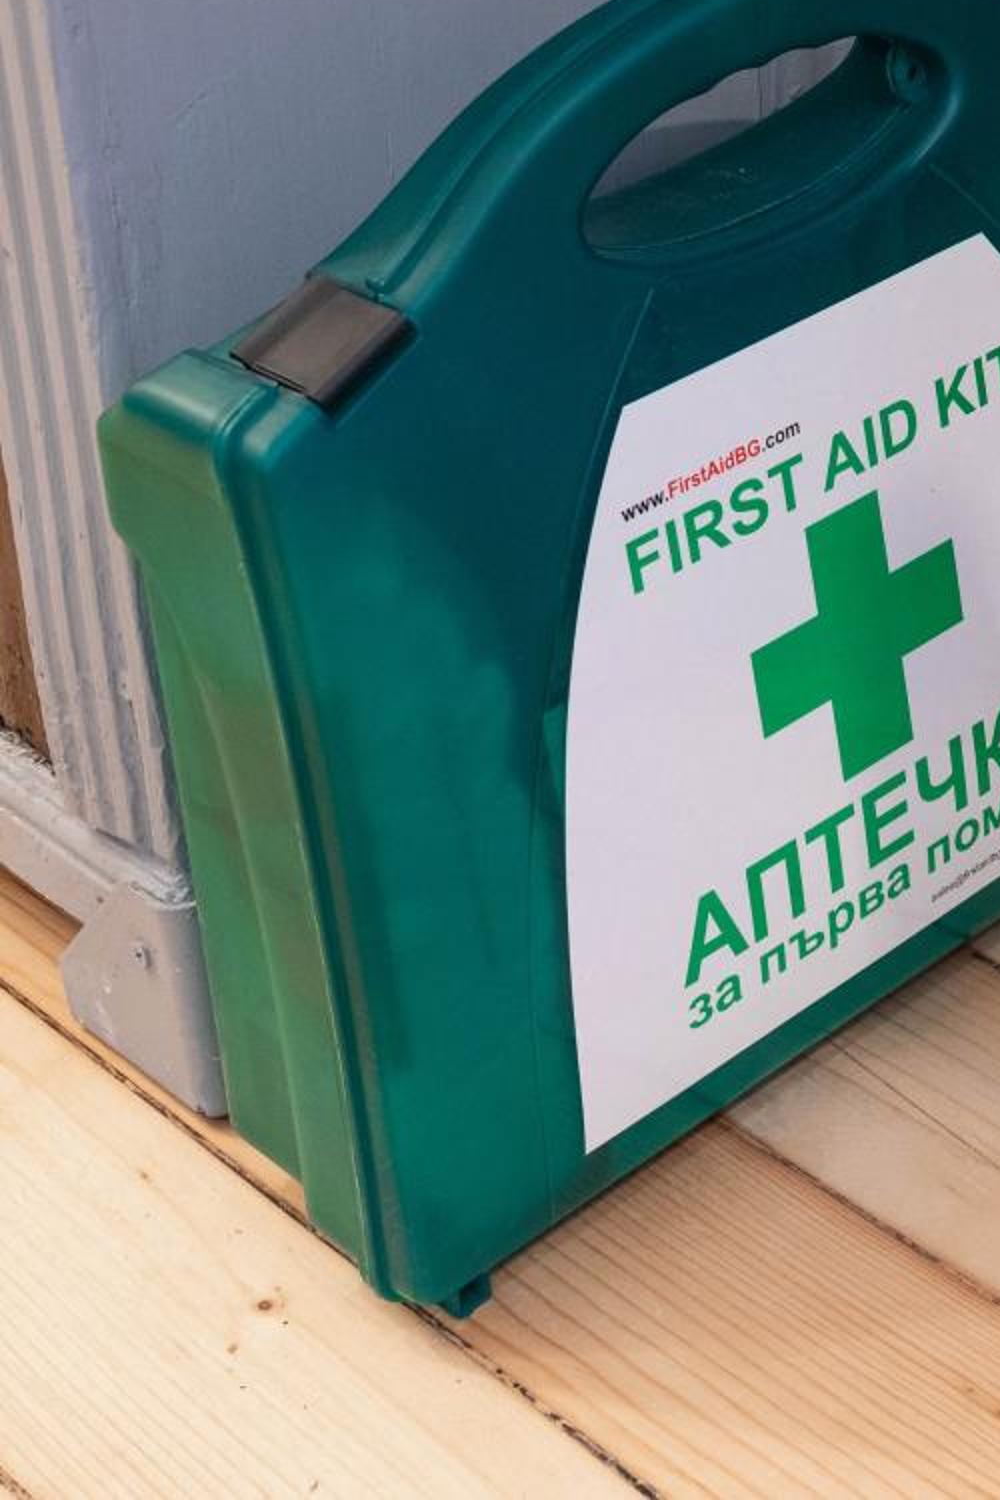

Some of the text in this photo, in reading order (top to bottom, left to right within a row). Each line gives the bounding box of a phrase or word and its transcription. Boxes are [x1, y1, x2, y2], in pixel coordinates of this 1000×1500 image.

[621, 420, 802, 522] www.FirstAidBG.com
[625, 452, 803, 594] FIRST
[824, 399, 918, 492] AID
[688, 972, 743, 1030] за
[759, 862, 911, 986] първа
